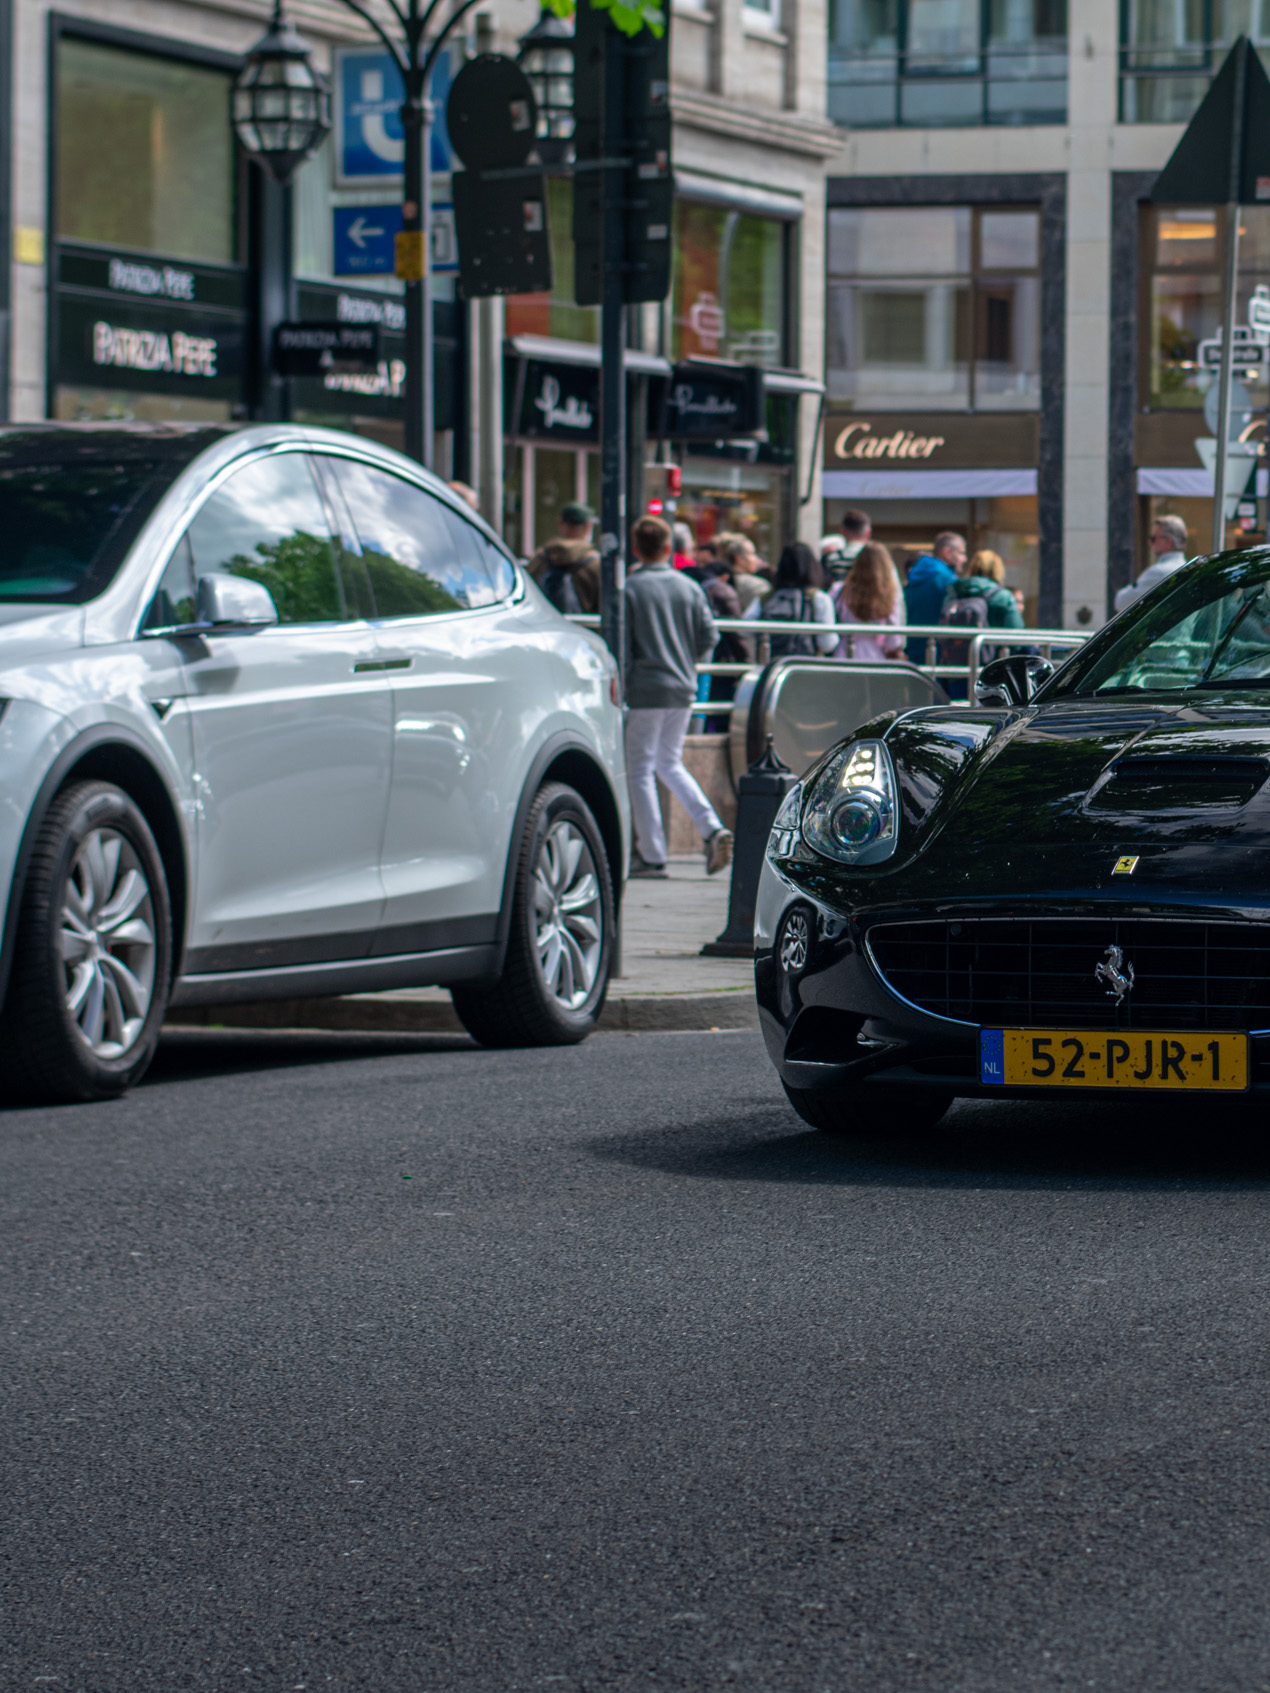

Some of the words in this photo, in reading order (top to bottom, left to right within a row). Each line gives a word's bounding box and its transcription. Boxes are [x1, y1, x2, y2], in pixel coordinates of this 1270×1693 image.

[163, 266, 195, 300] PEPE
[93, 320, 173, 372] PATRIZIA
[172, 331, 217, 377] PEPE
[834, 422, 945, 458] Cartier
[984, 1062, 1000, 1074] NL
[1031, 1038, 1220, 1081] 52-PJR-1
